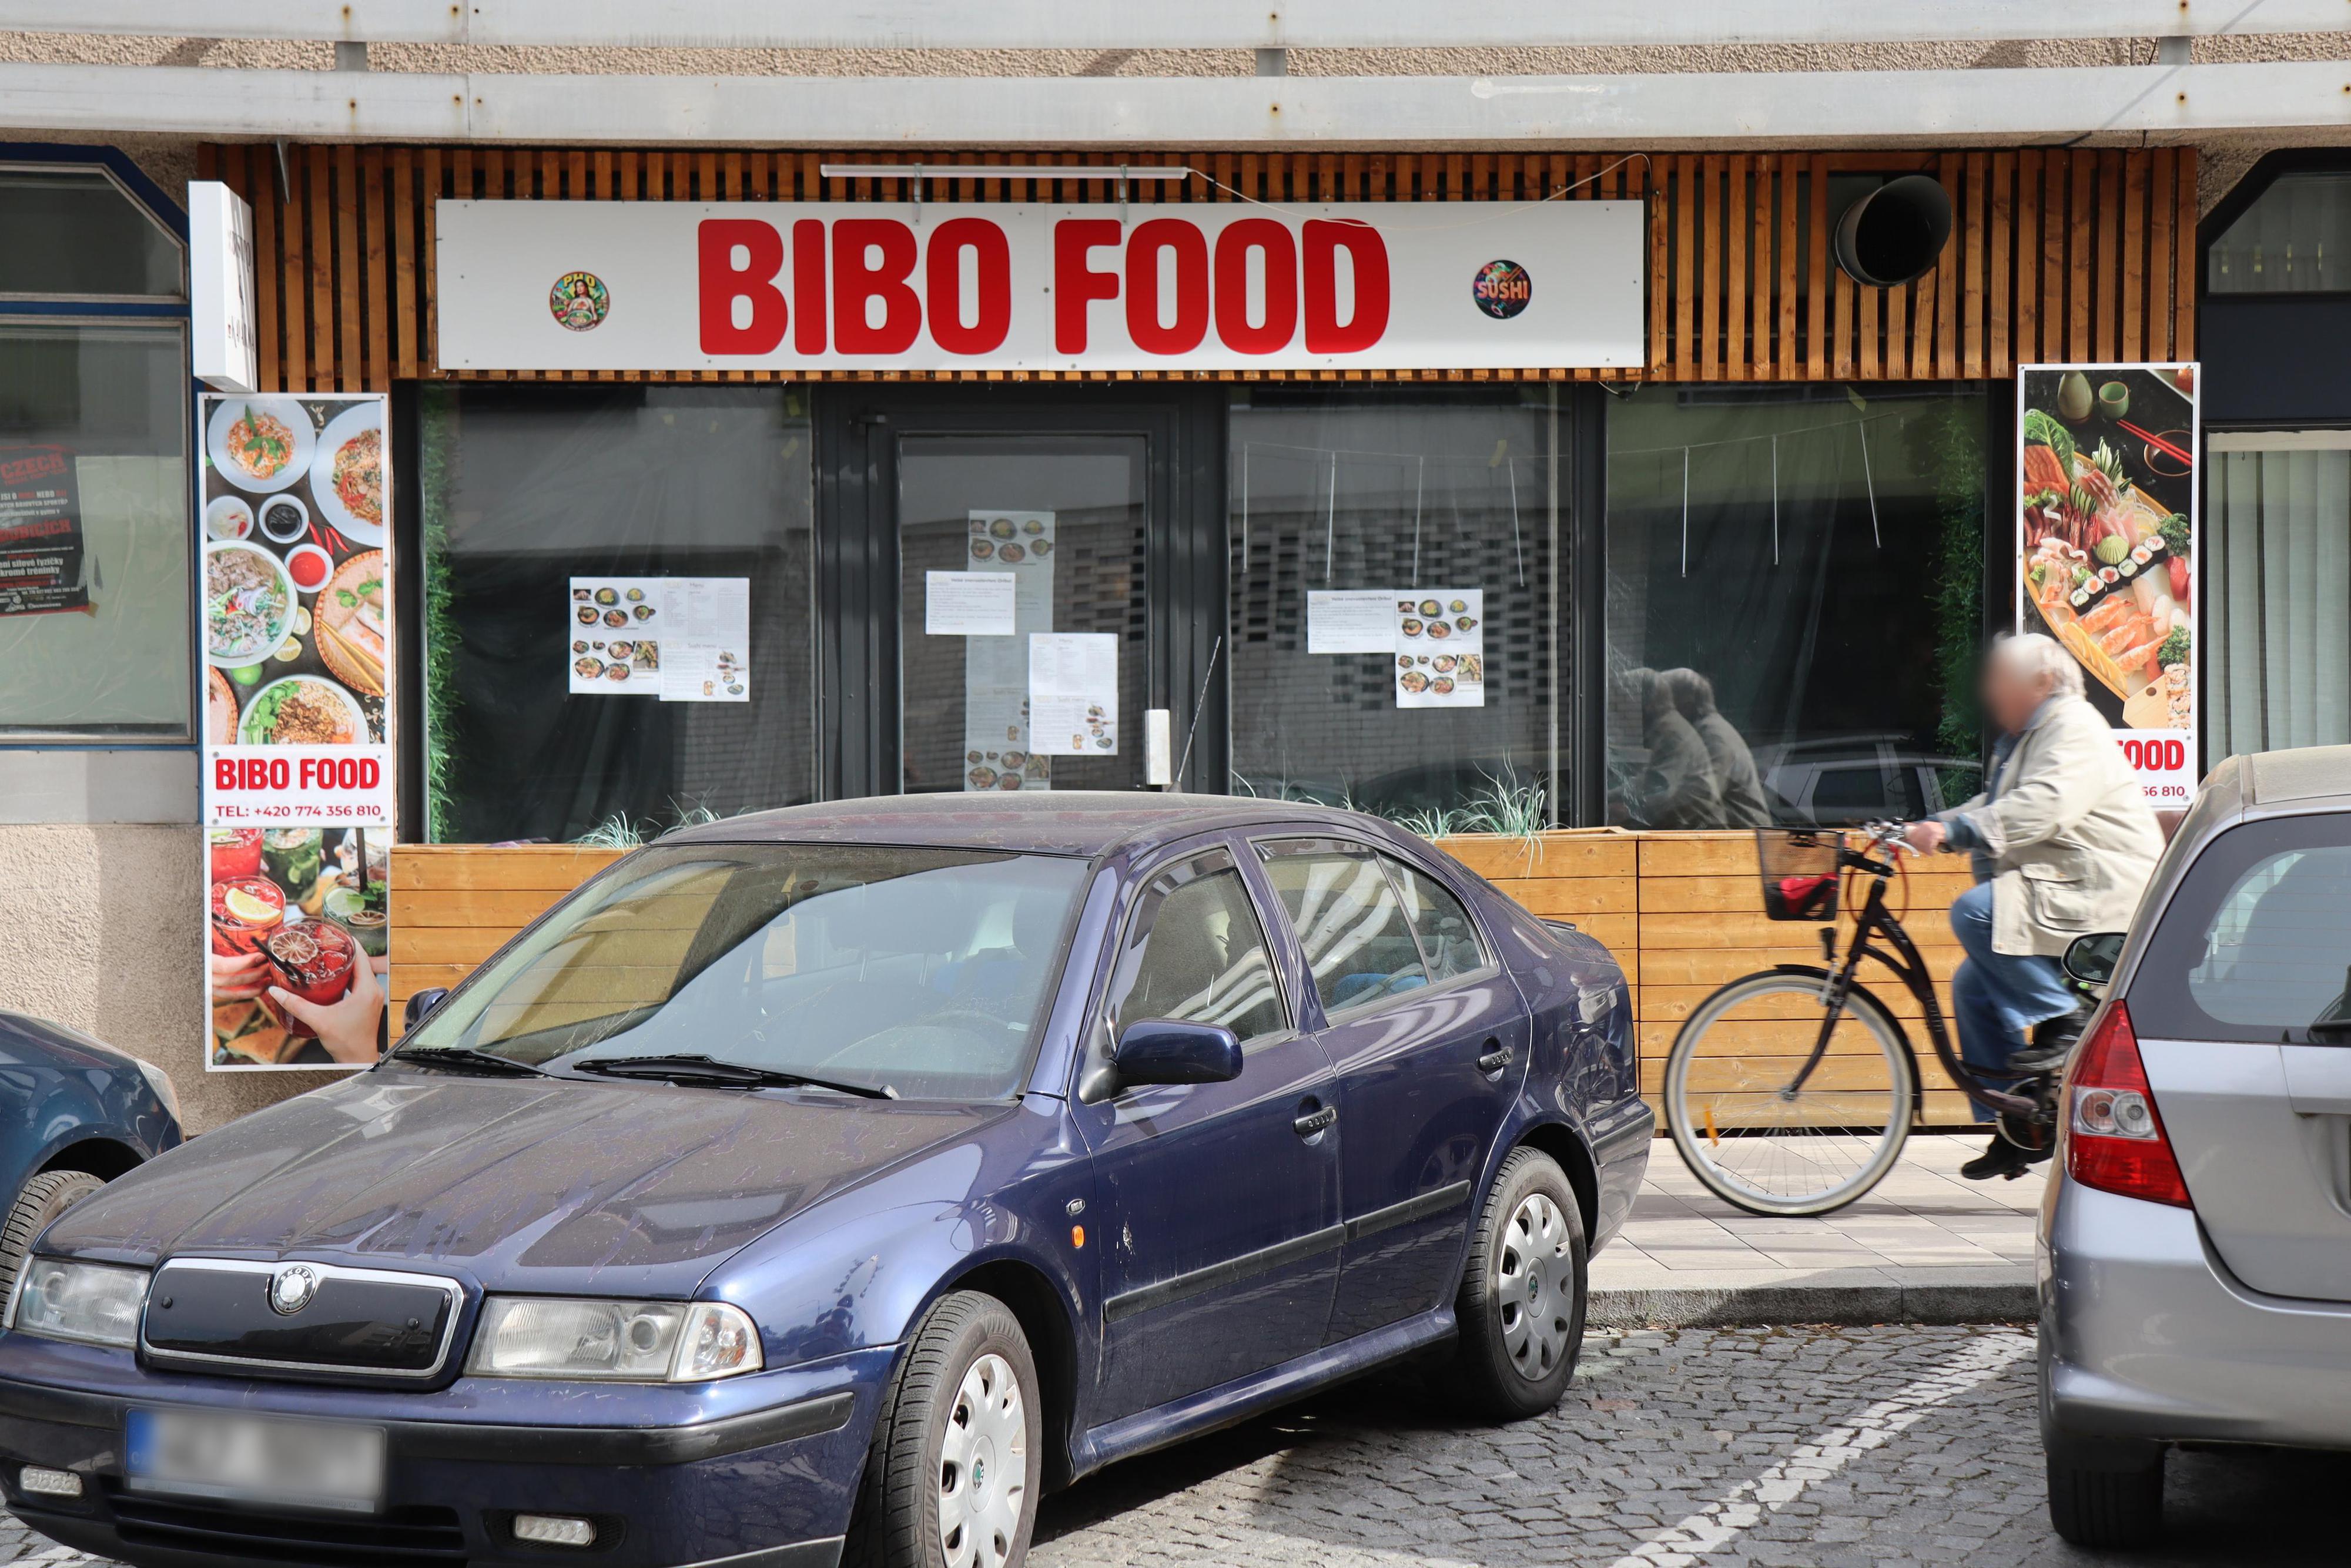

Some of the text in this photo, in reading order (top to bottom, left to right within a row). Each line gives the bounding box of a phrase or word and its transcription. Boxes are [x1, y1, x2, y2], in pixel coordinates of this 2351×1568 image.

[562, 273, 597, 288] PHO
[698, 217, 1390, 355] BIBO FOOD
[1477, 280, 1529, 299] SUSHI
[1, 452, 66, 480] CZECH
[36, 490, 55, 498] NEBO
[12, 559, 36, 567] silové
[36, 557, 63, 566] fyzičky
[26, 566, 60, 575] tréninky
[2117, 739, 2185, 770] OOD
[216, 758, 380, 790] BIBO FOOD
[2143, 786, 2185, 796] 56 810
[215, 805, 381, 817] TEL: +420 774 356 810
